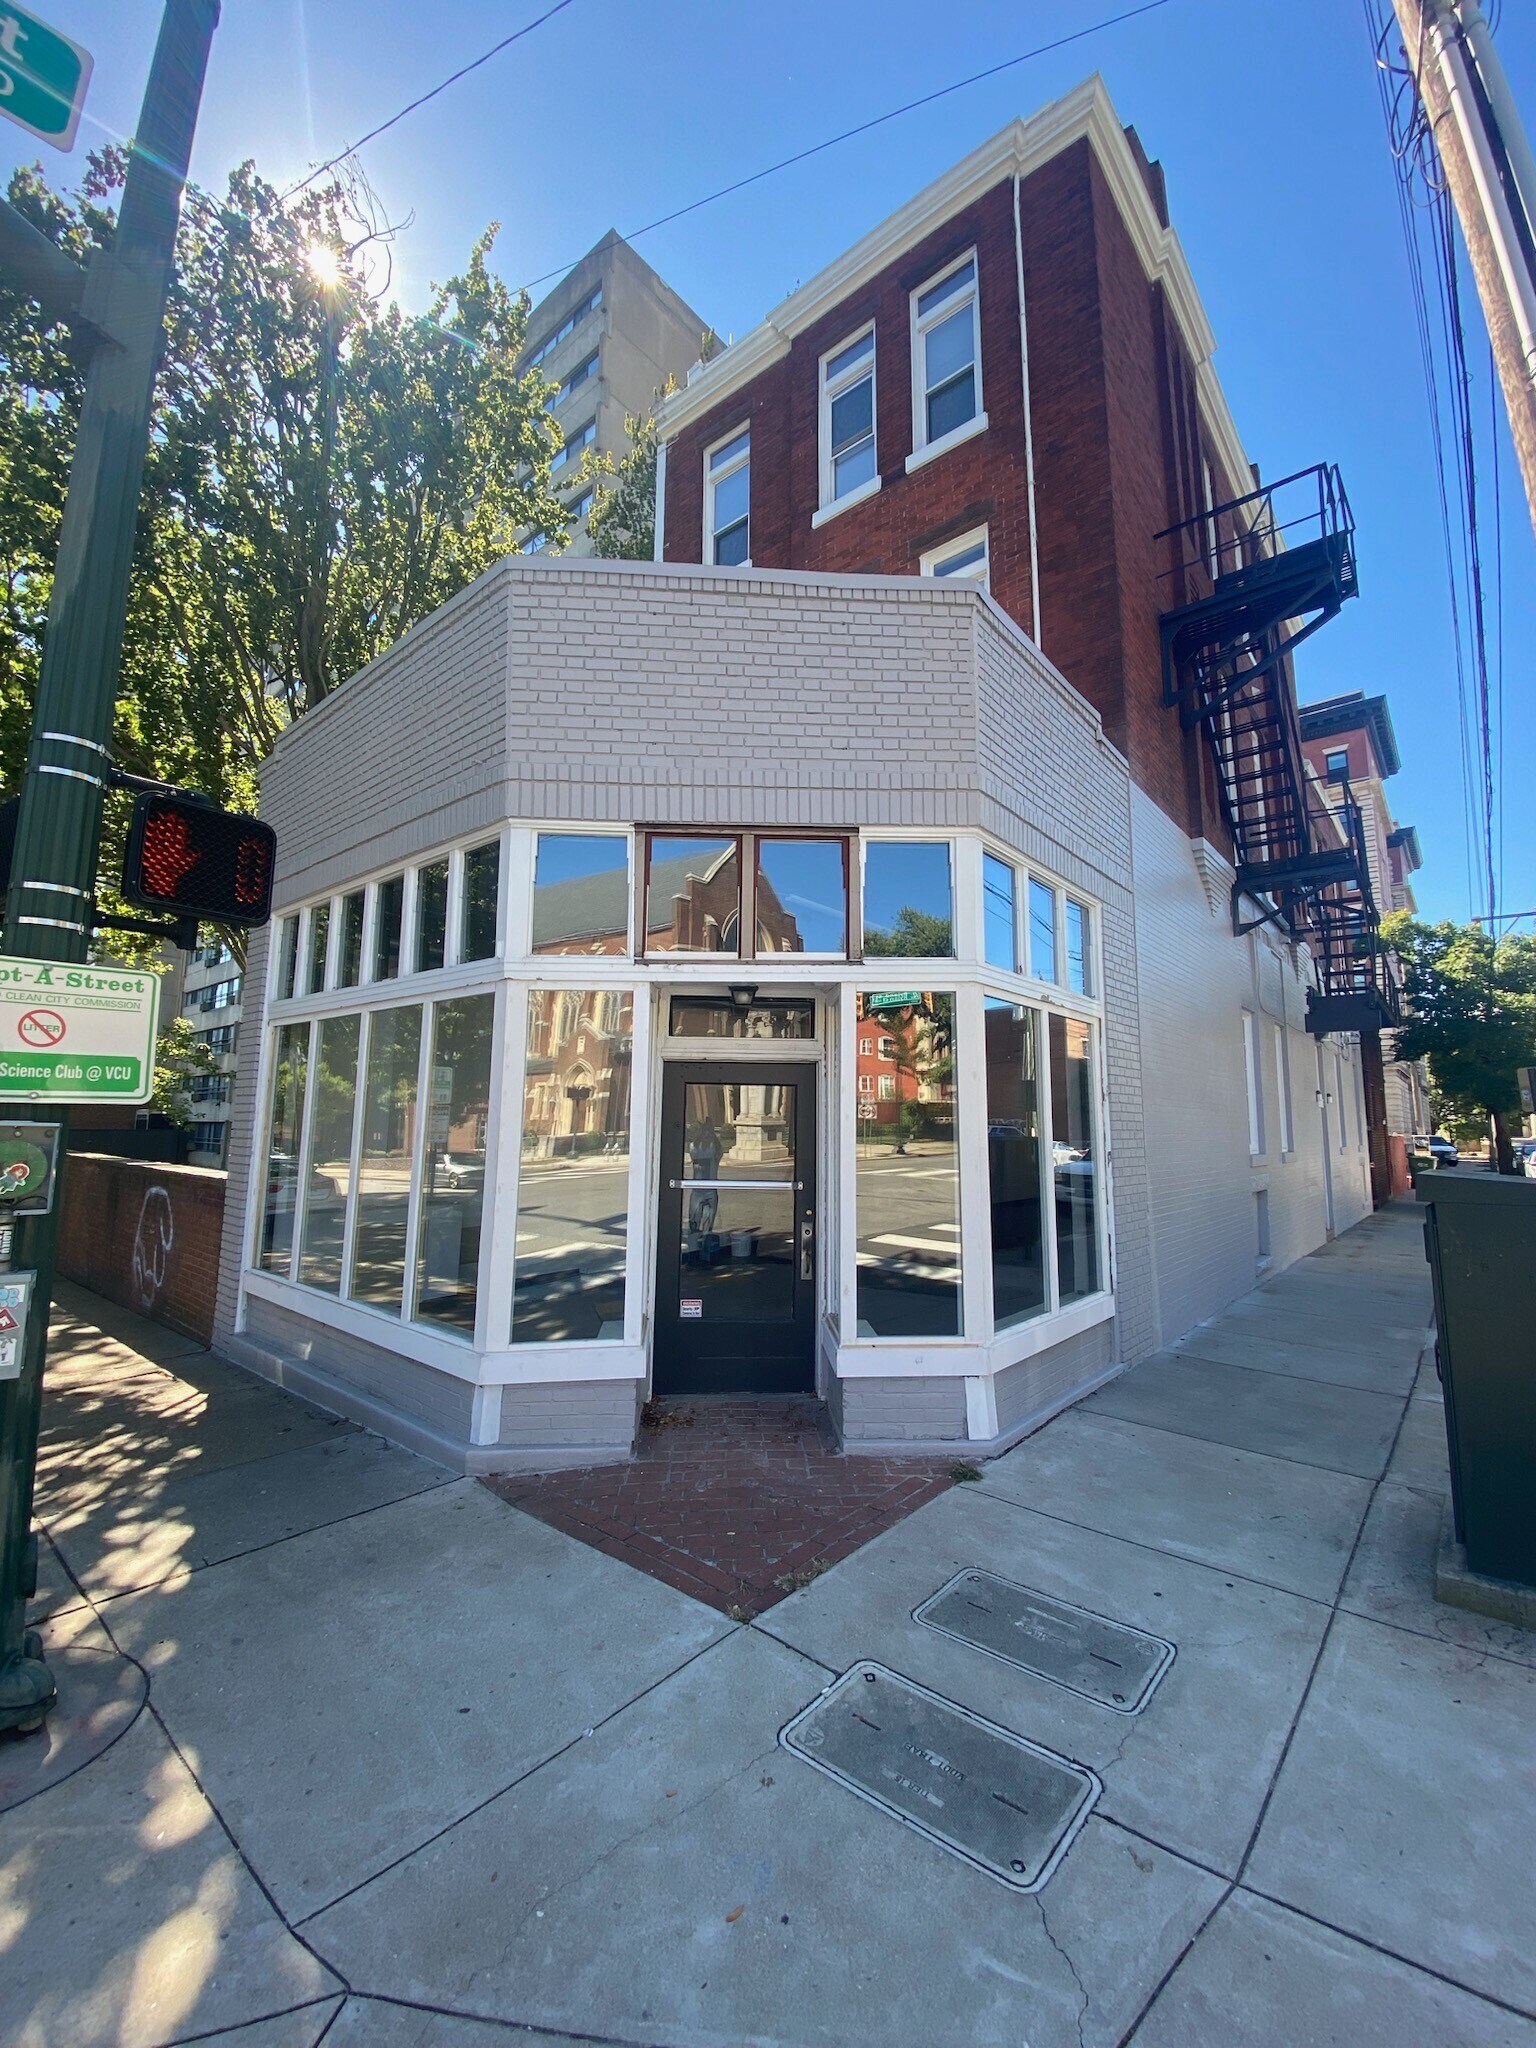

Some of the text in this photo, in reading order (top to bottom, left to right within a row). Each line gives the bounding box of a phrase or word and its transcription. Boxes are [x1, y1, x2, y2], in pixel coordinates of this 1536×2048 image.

[6, 991, 141, 1010] CLEAN CITY COMMISSION
[0, 1062, 132, 1082] Science Club @ VCU
